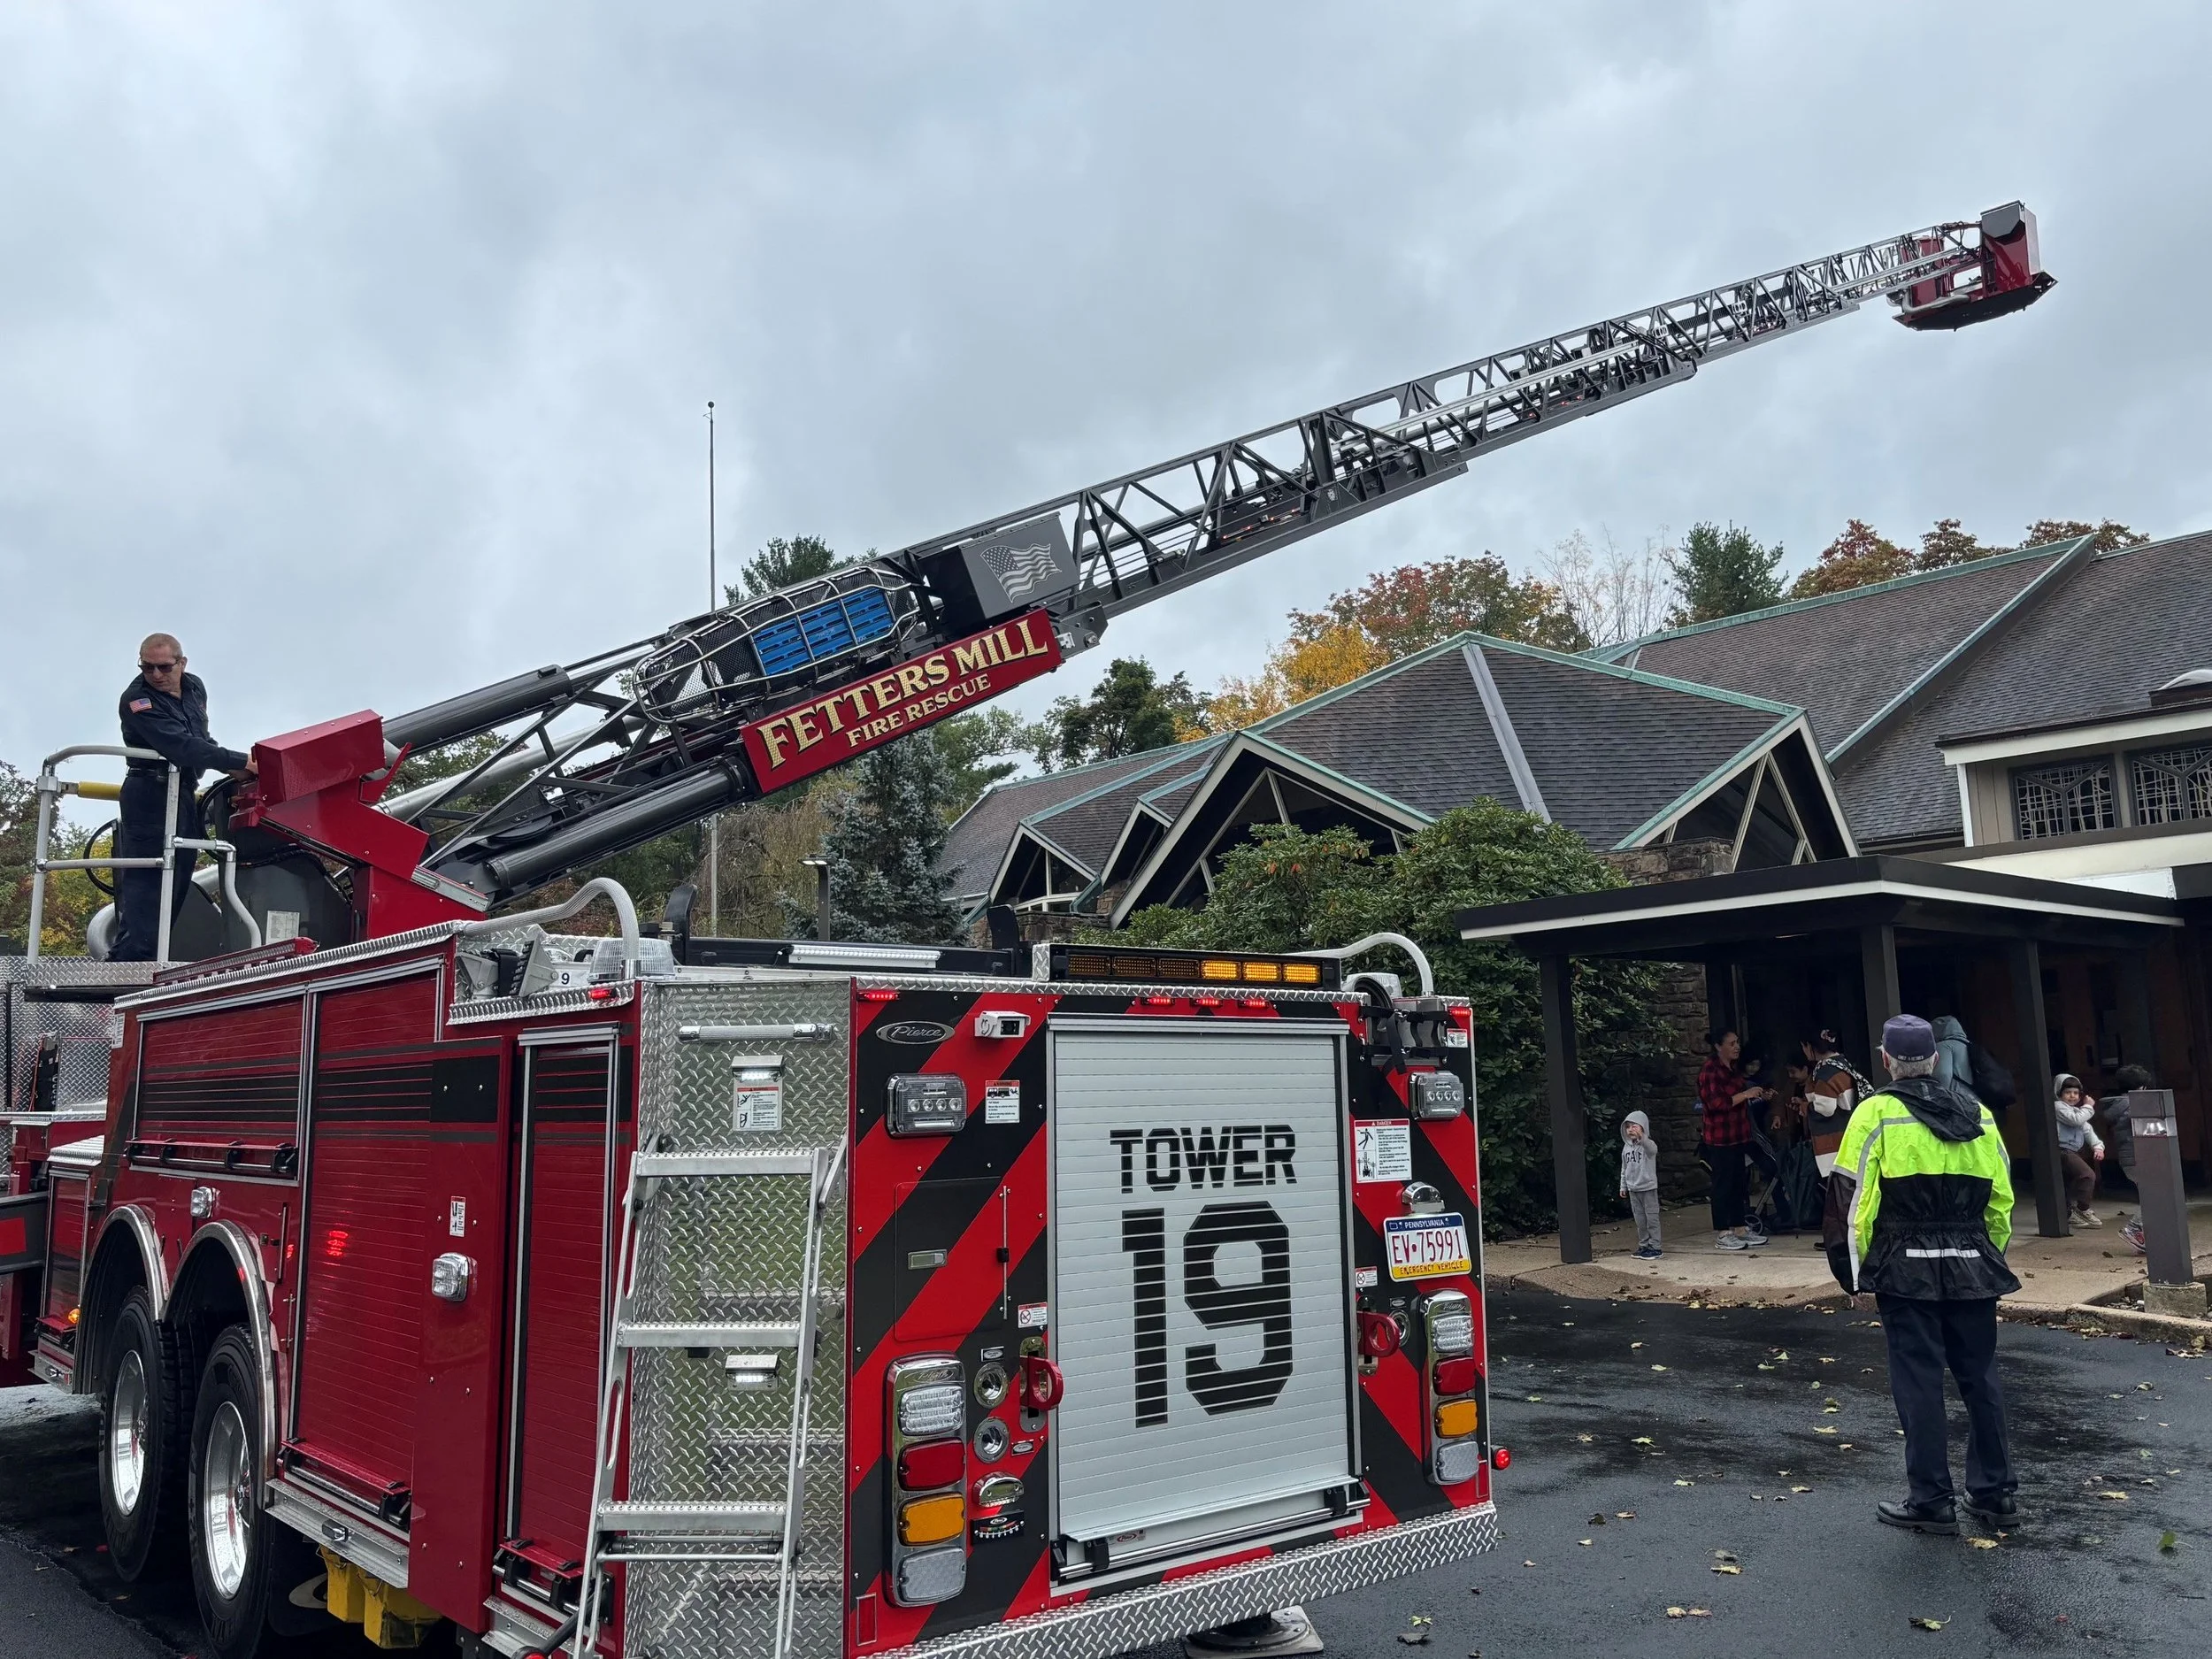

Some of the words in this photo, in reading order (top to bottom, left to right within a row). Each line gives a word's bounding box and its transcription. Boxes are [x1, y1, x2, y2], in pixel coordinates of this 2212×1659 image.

[757, 654, 950, 770] FETTERS
[951, 618, 1048, 676] MILL
[845, 714, 903, 748] FIRE
[905, 673, 991, 723] RESCUE
[561, 973, 571, 985] 9
[891, 1026, 942, 1038] Pierce
[1110, 1125, 1297, 1194] TOWER
[1404, 1219, 1445, 1229] PENNSYLVANIA
[1400, 1263, 1433, 1275] EMERGENCY
[1437, 1261, 1464, 1271] VEHICLE
[1122, 1201, 1293, 1428] 19
